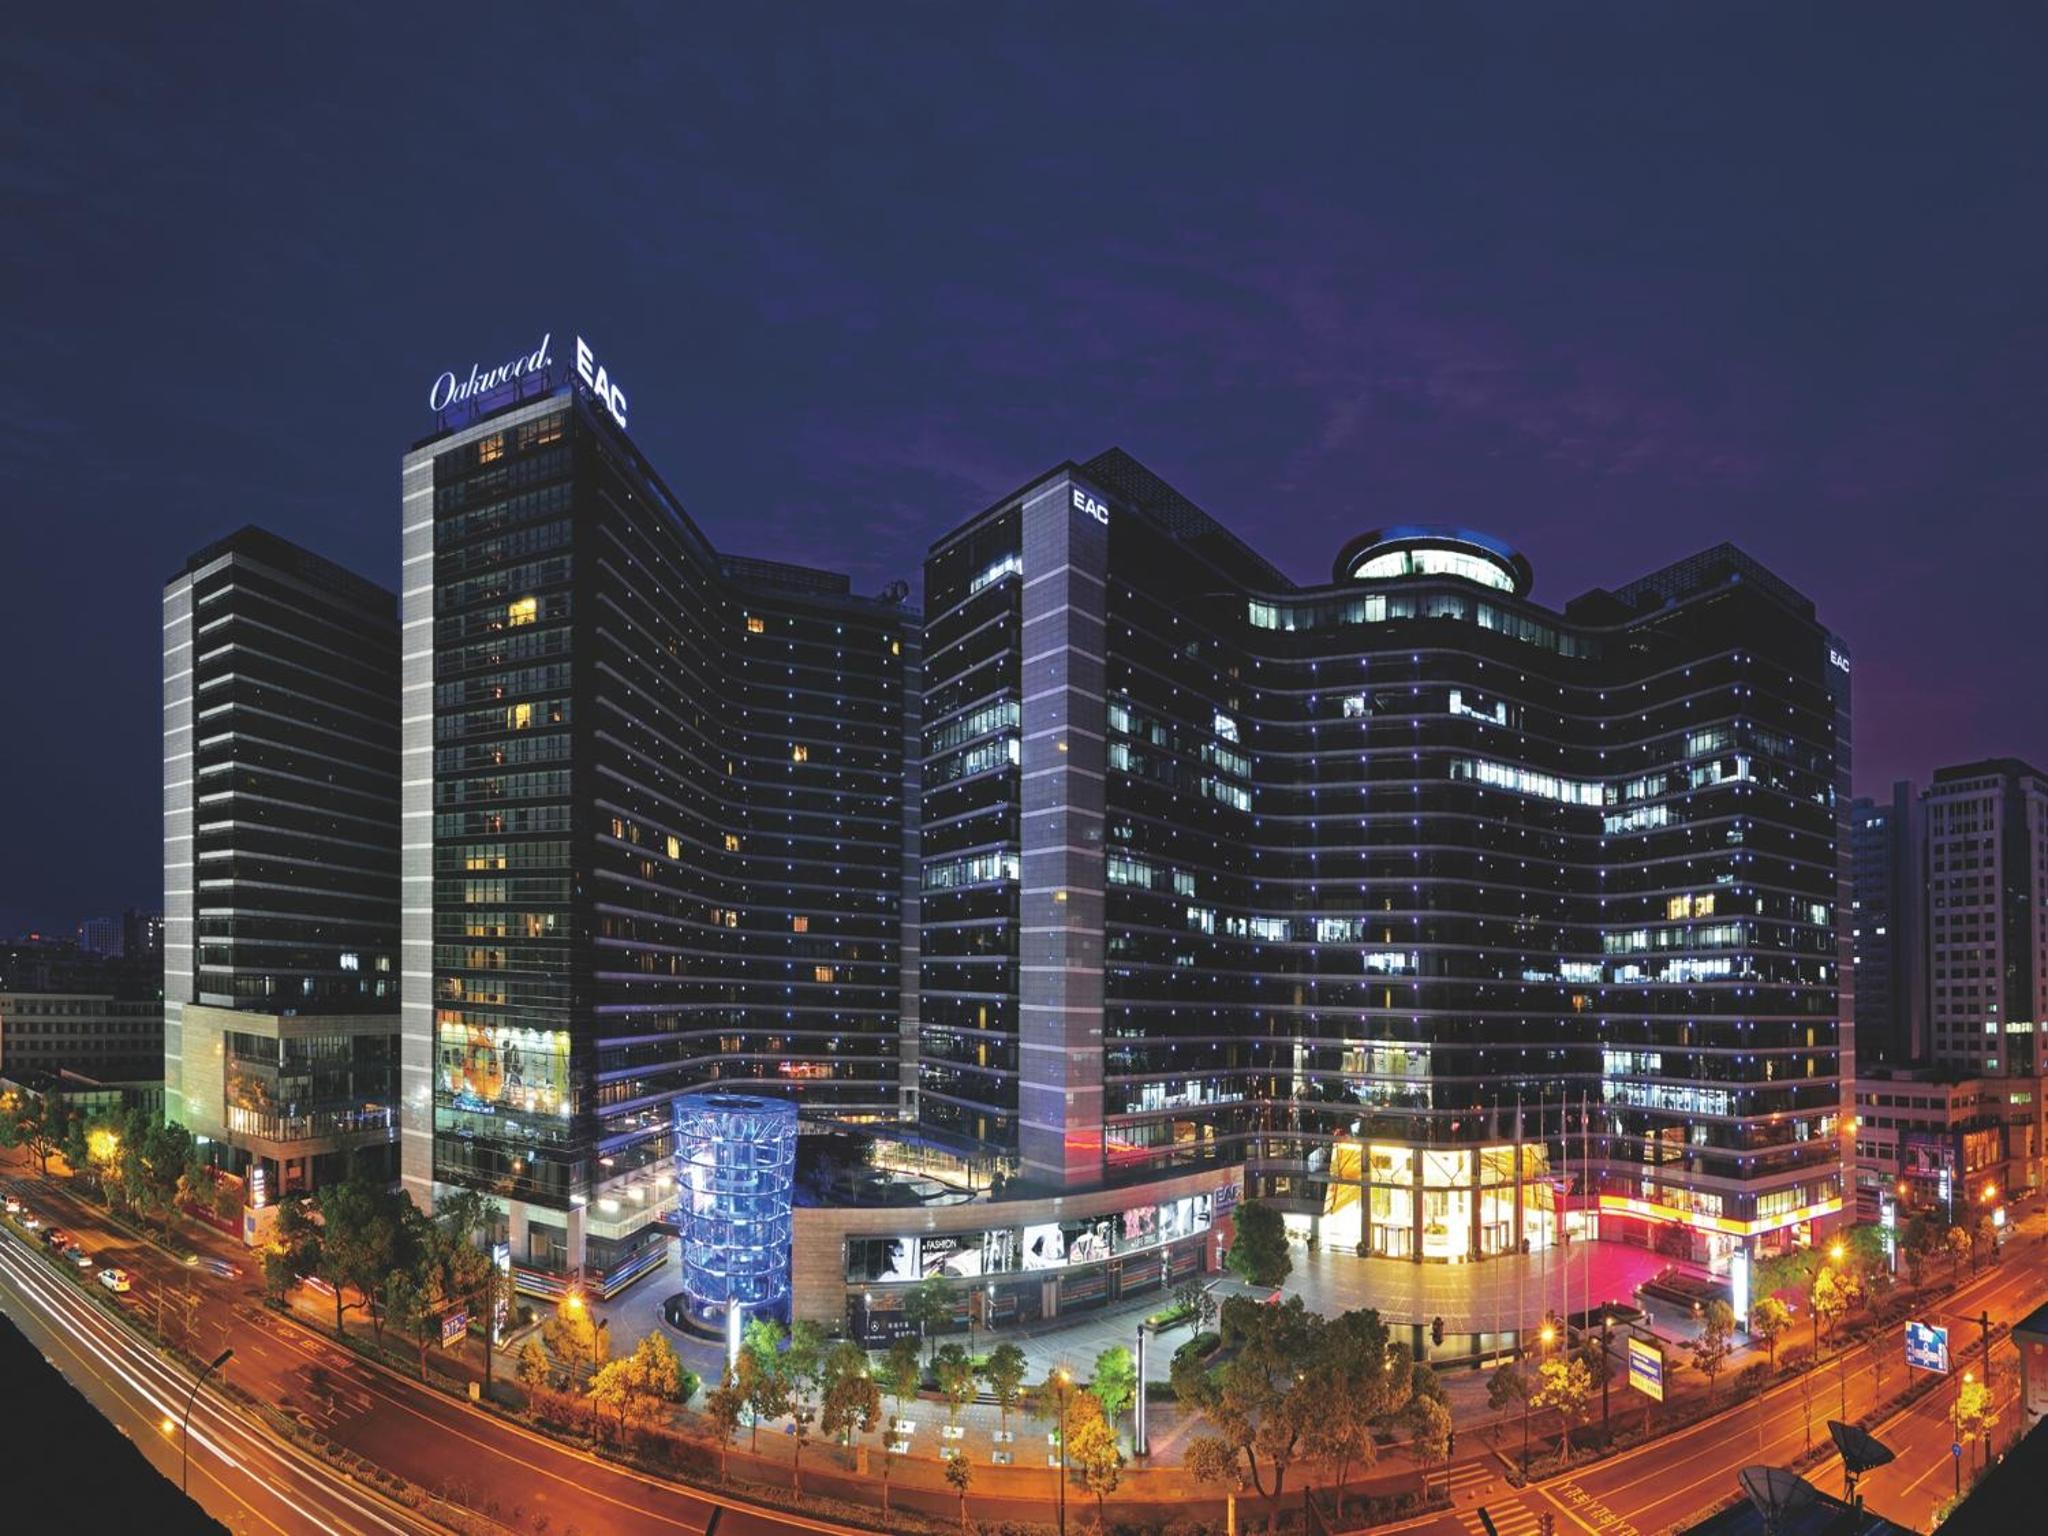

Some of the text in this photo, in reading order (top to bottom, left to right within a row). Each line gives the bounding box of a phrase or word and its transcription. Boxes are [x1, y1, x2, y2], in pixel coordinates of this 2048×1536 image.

[576, 335, 627, 429] EAC
[1073, 488, 1109, 525] EAC
[1830, 649, 1850, 673] EAC
